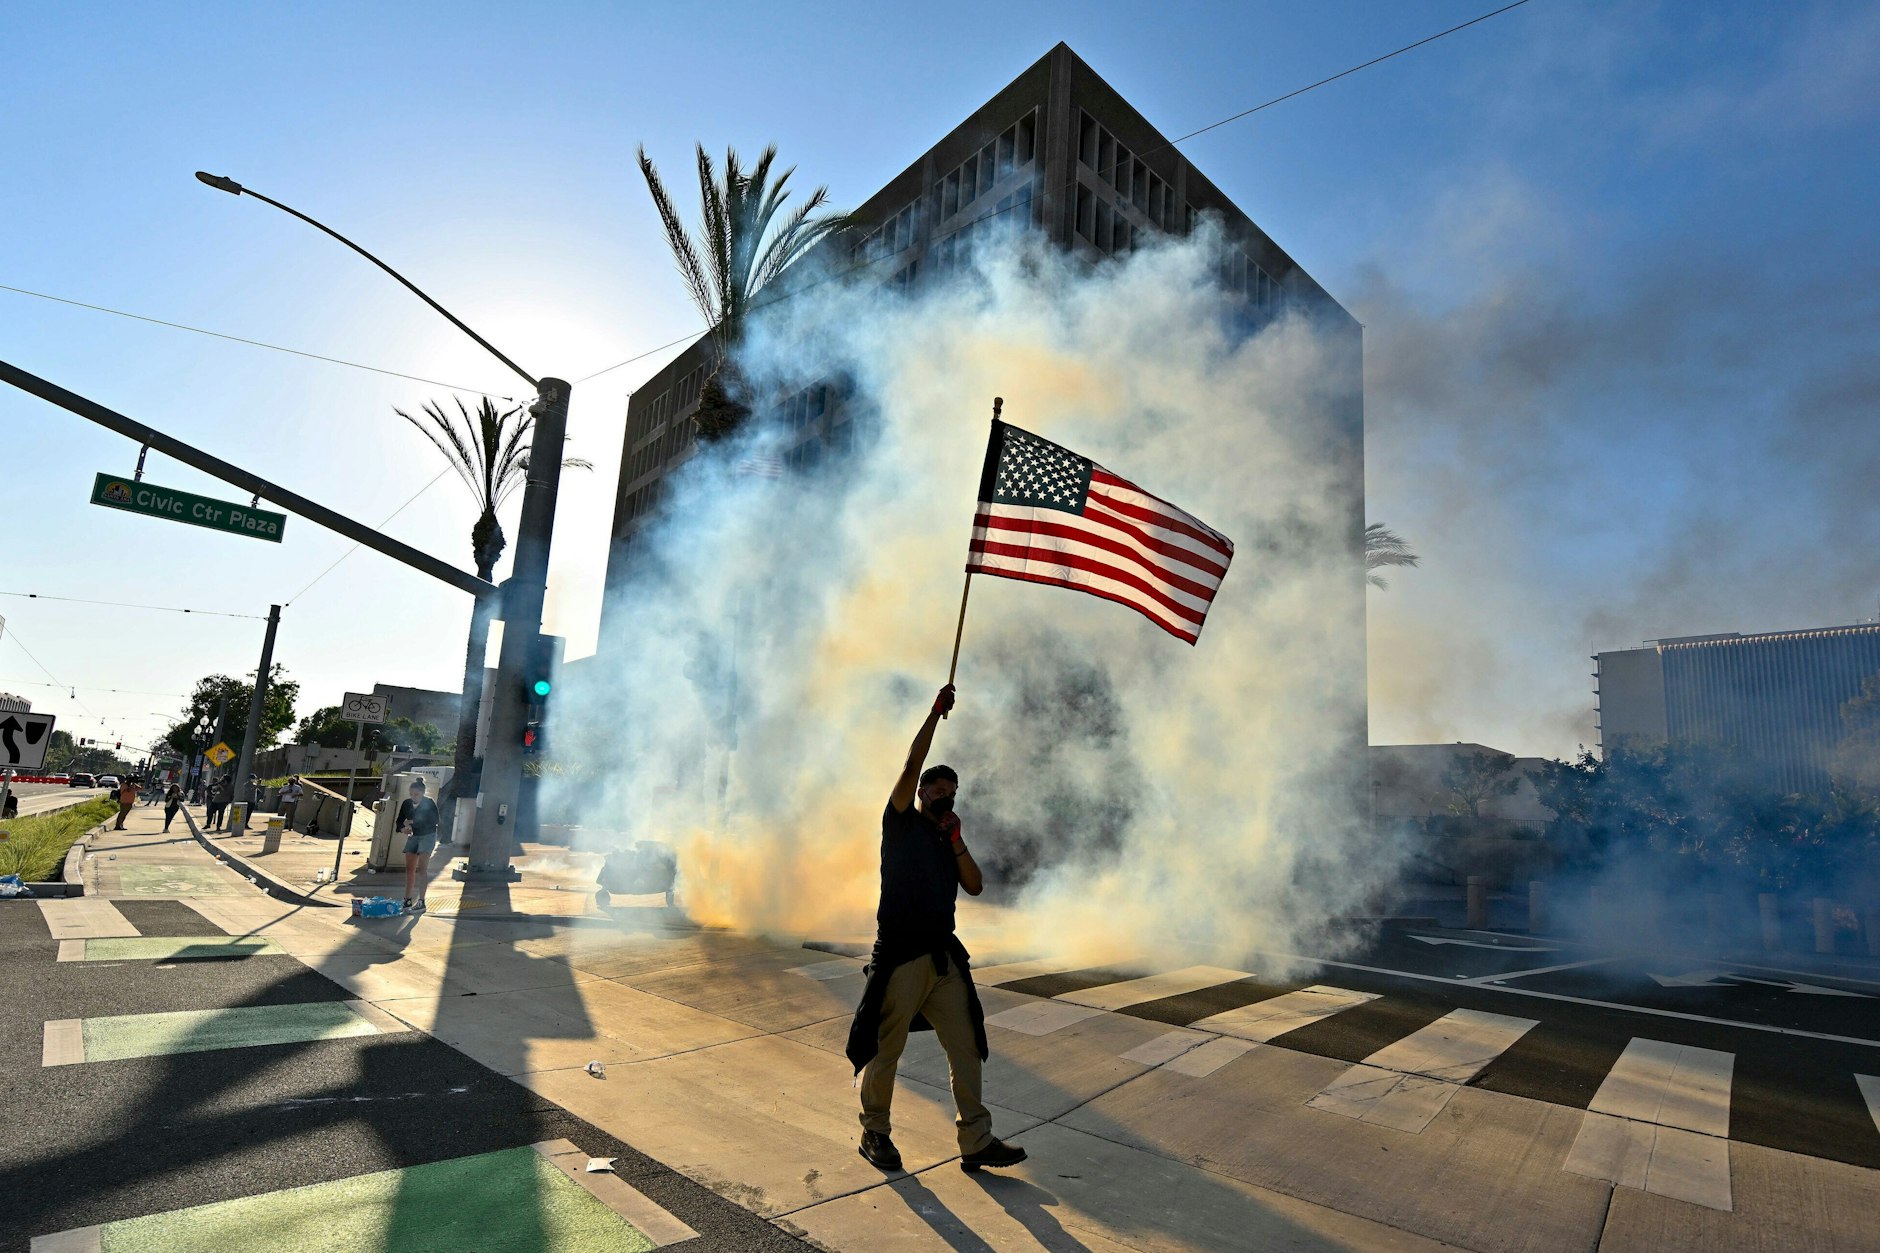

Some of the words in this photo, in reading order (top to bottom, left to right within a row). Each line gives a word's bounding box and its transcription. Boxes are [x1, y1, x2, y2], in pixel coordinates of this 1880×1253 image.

[136, 490, 184, 514] Civic
[192, 502, 222, 522] Ctr
[229, 510, 277, 534] Plaza
